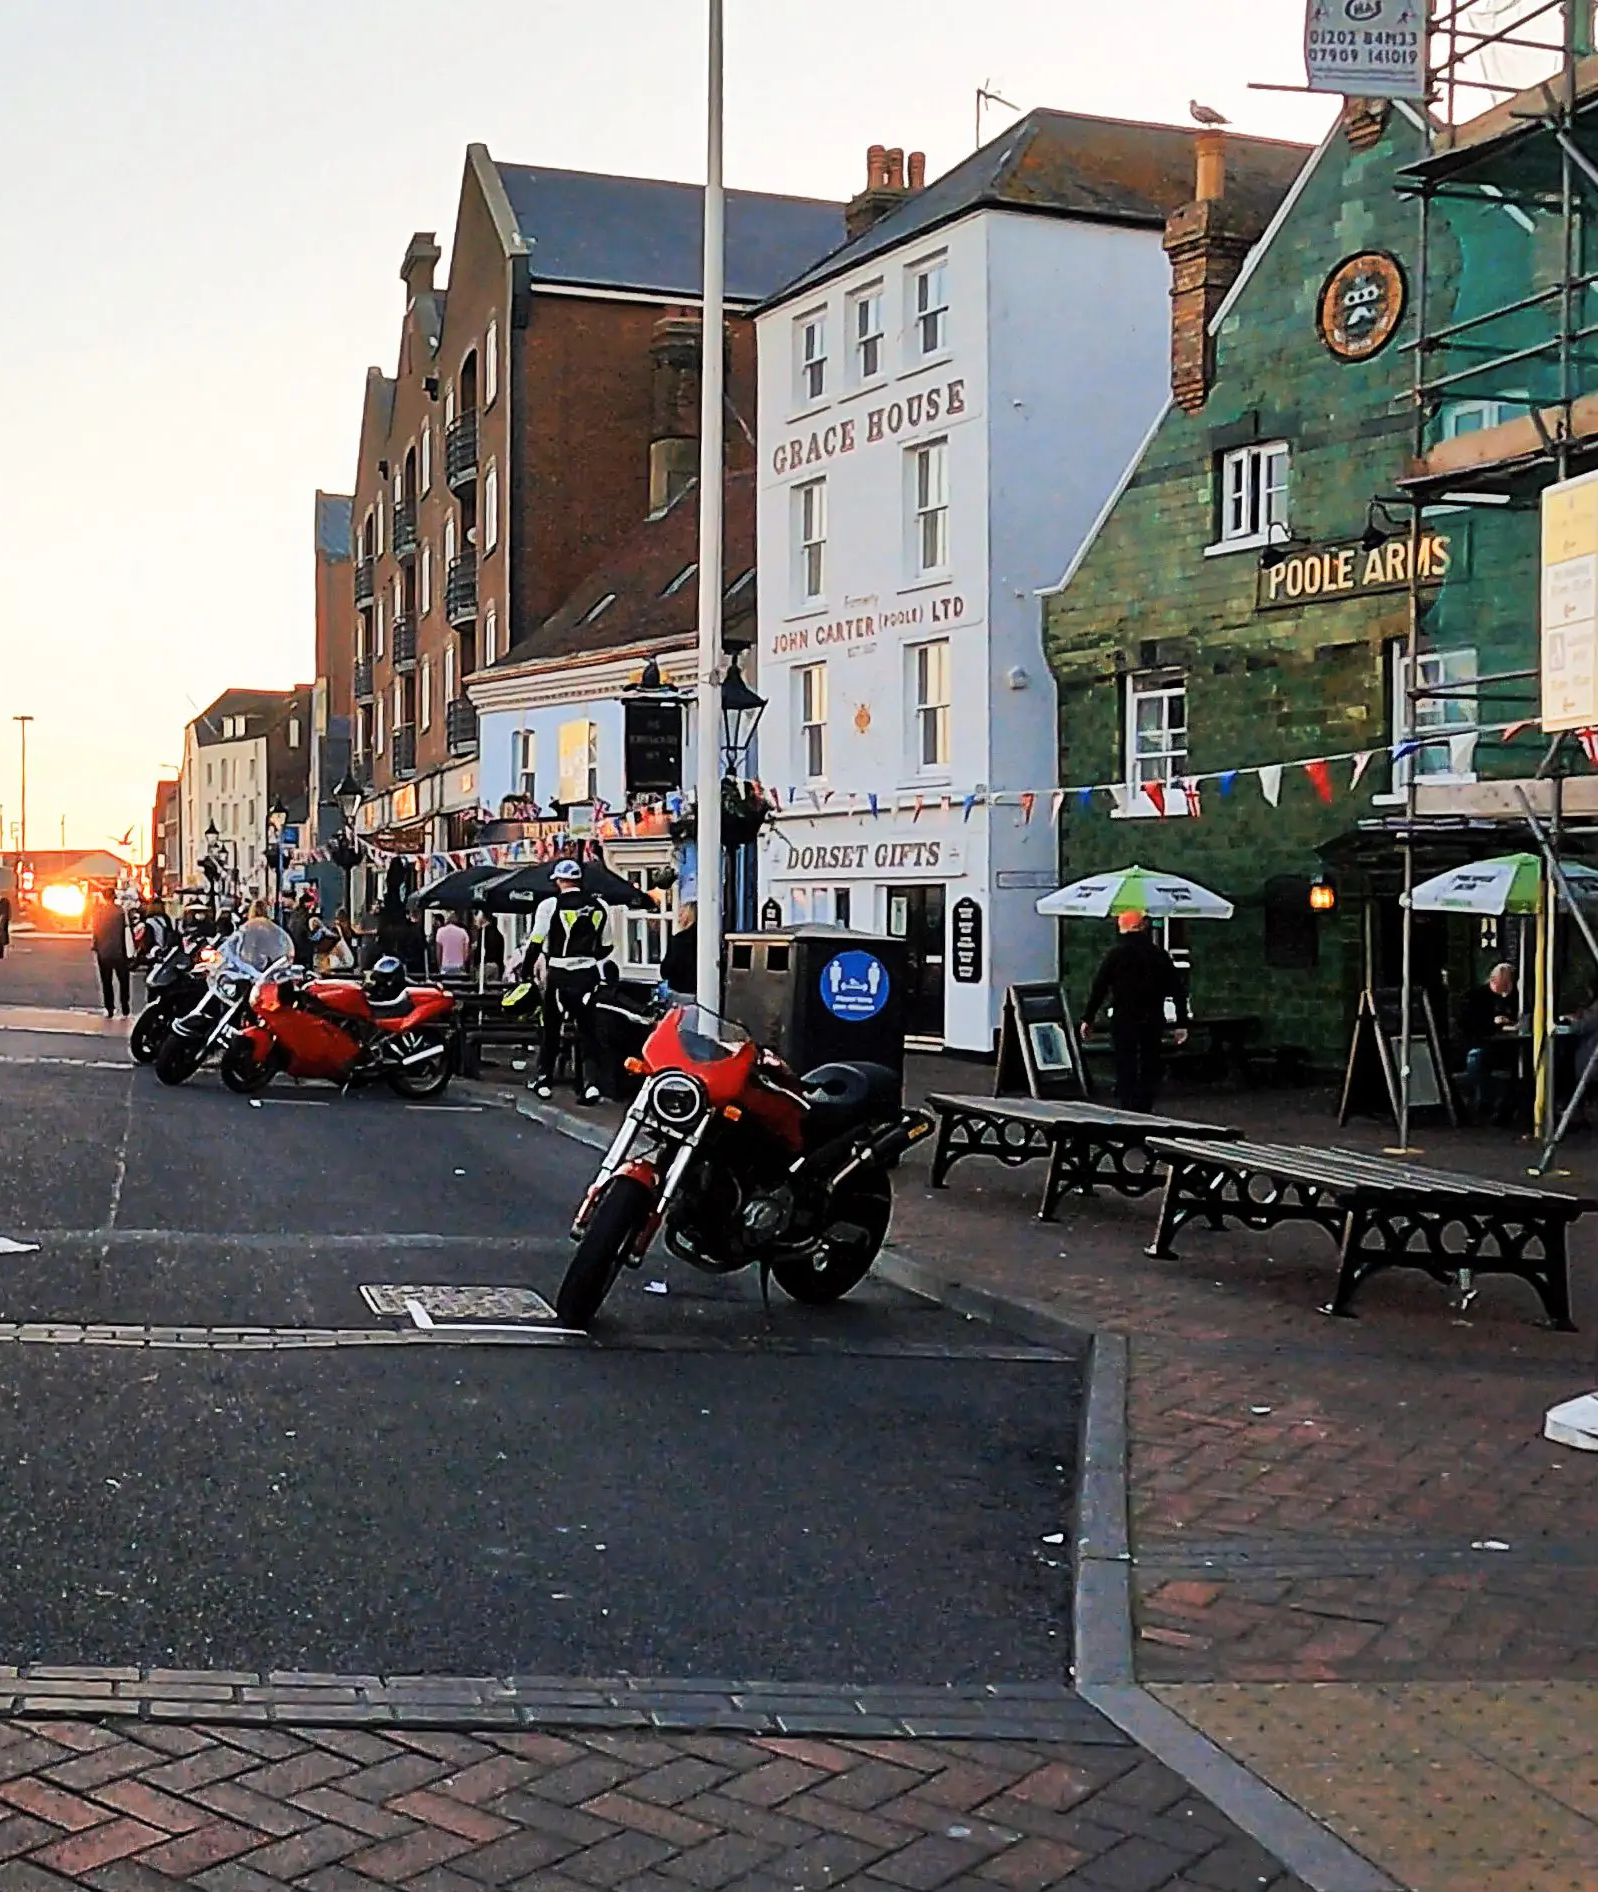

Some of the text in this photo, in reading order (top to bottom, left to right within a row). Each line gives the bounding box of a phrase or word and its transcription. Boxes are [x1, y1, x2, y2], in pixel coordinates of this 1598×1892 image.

[1308, 48, 1358, 62] 07909
[1309, 29, 1357, 46] 01202
[772, 379, 966, 476] GRACE HOUSE
[1269, 536, 1451, 600] POOLE ARMS
[772, 596, 964, 655] JOHN CARTER (POOLE) LTD
[787, 841, 941, 871] DORSET GIFTS
